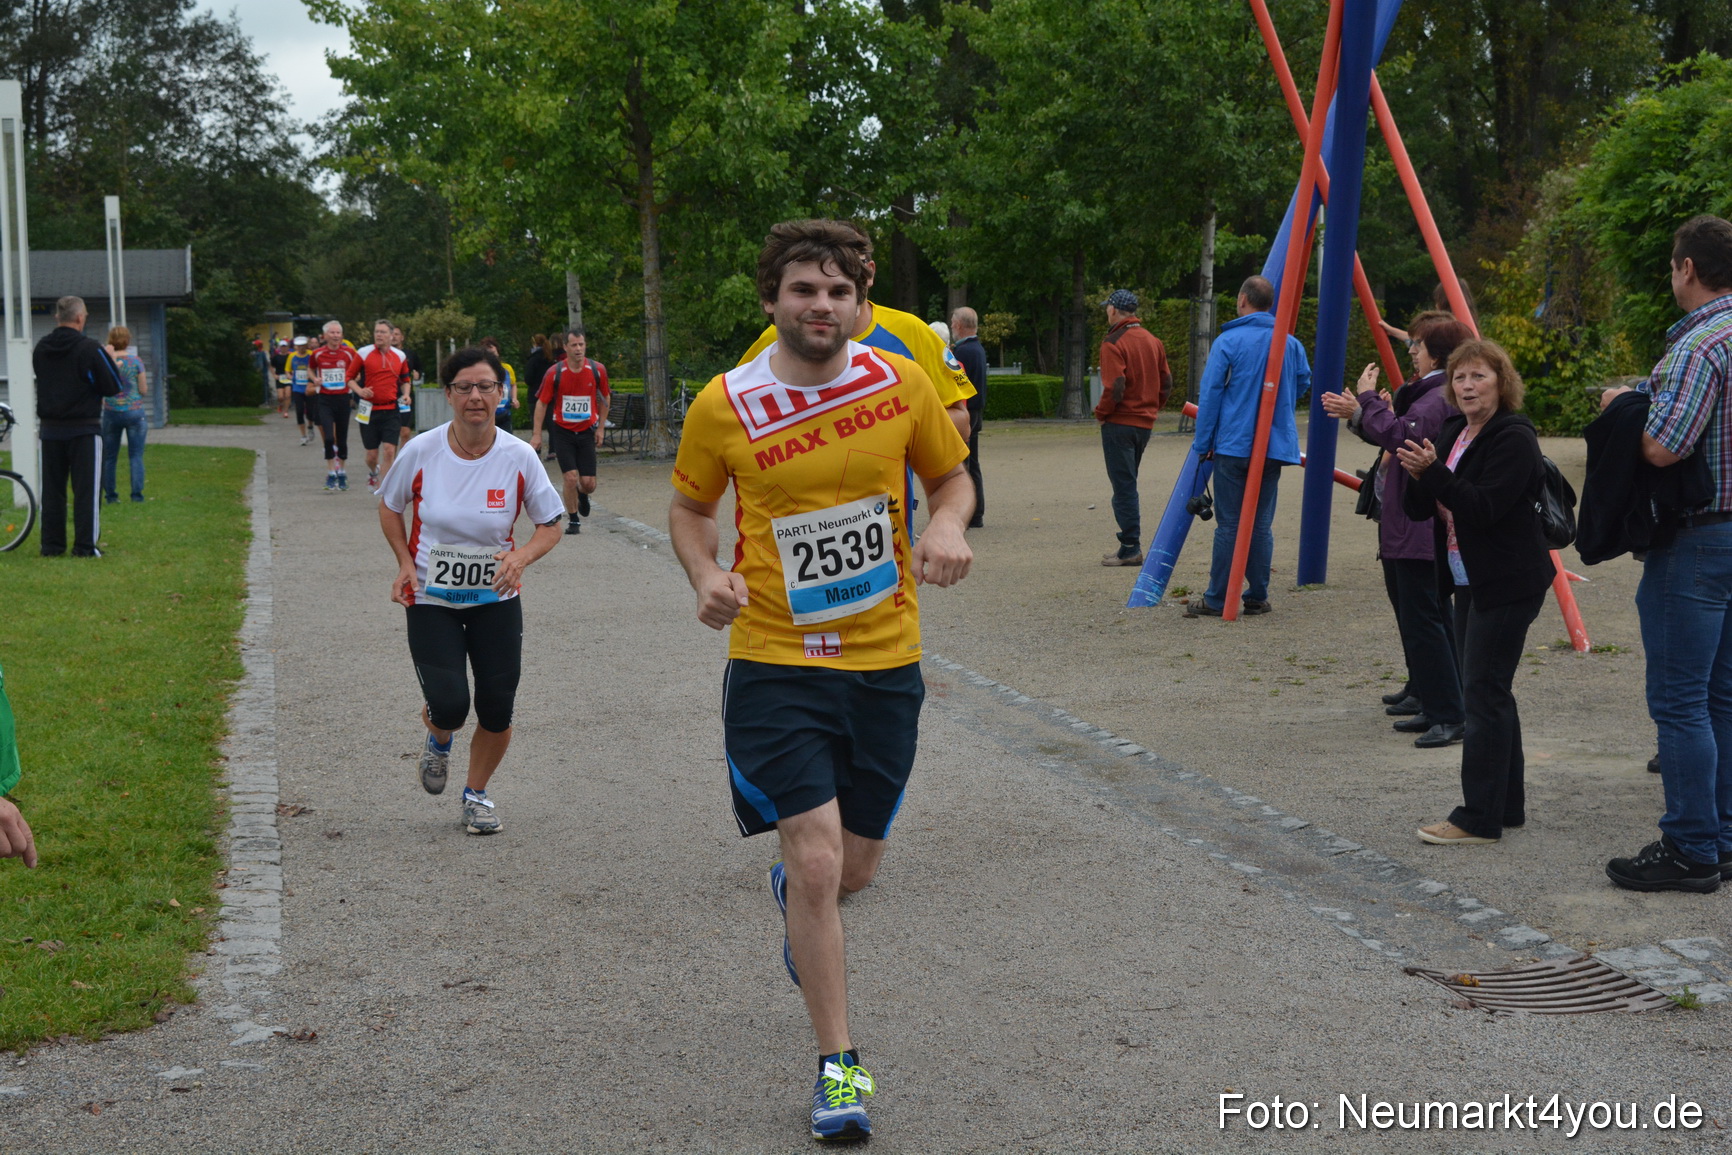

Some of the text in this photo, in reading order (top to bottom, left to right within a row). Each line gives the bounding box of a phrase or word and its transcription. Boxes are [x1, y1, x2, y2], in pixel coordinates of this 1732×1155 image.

[324, 372, 343, 382] 2613
[565, 402, 588, 412] 2470
[754, 395, 909, 471] MAX BÖGL
[776, 509, 872, 540] PARTL Neumarkt
[430, 549, 493, 560] PARTL Neumarkt
[792, 522, 885, 583] 2539
[434, 560, 496, 587] 2905
[446, 591, 479, 603] Sibylle
[825, 581, 871, 604] Marco
